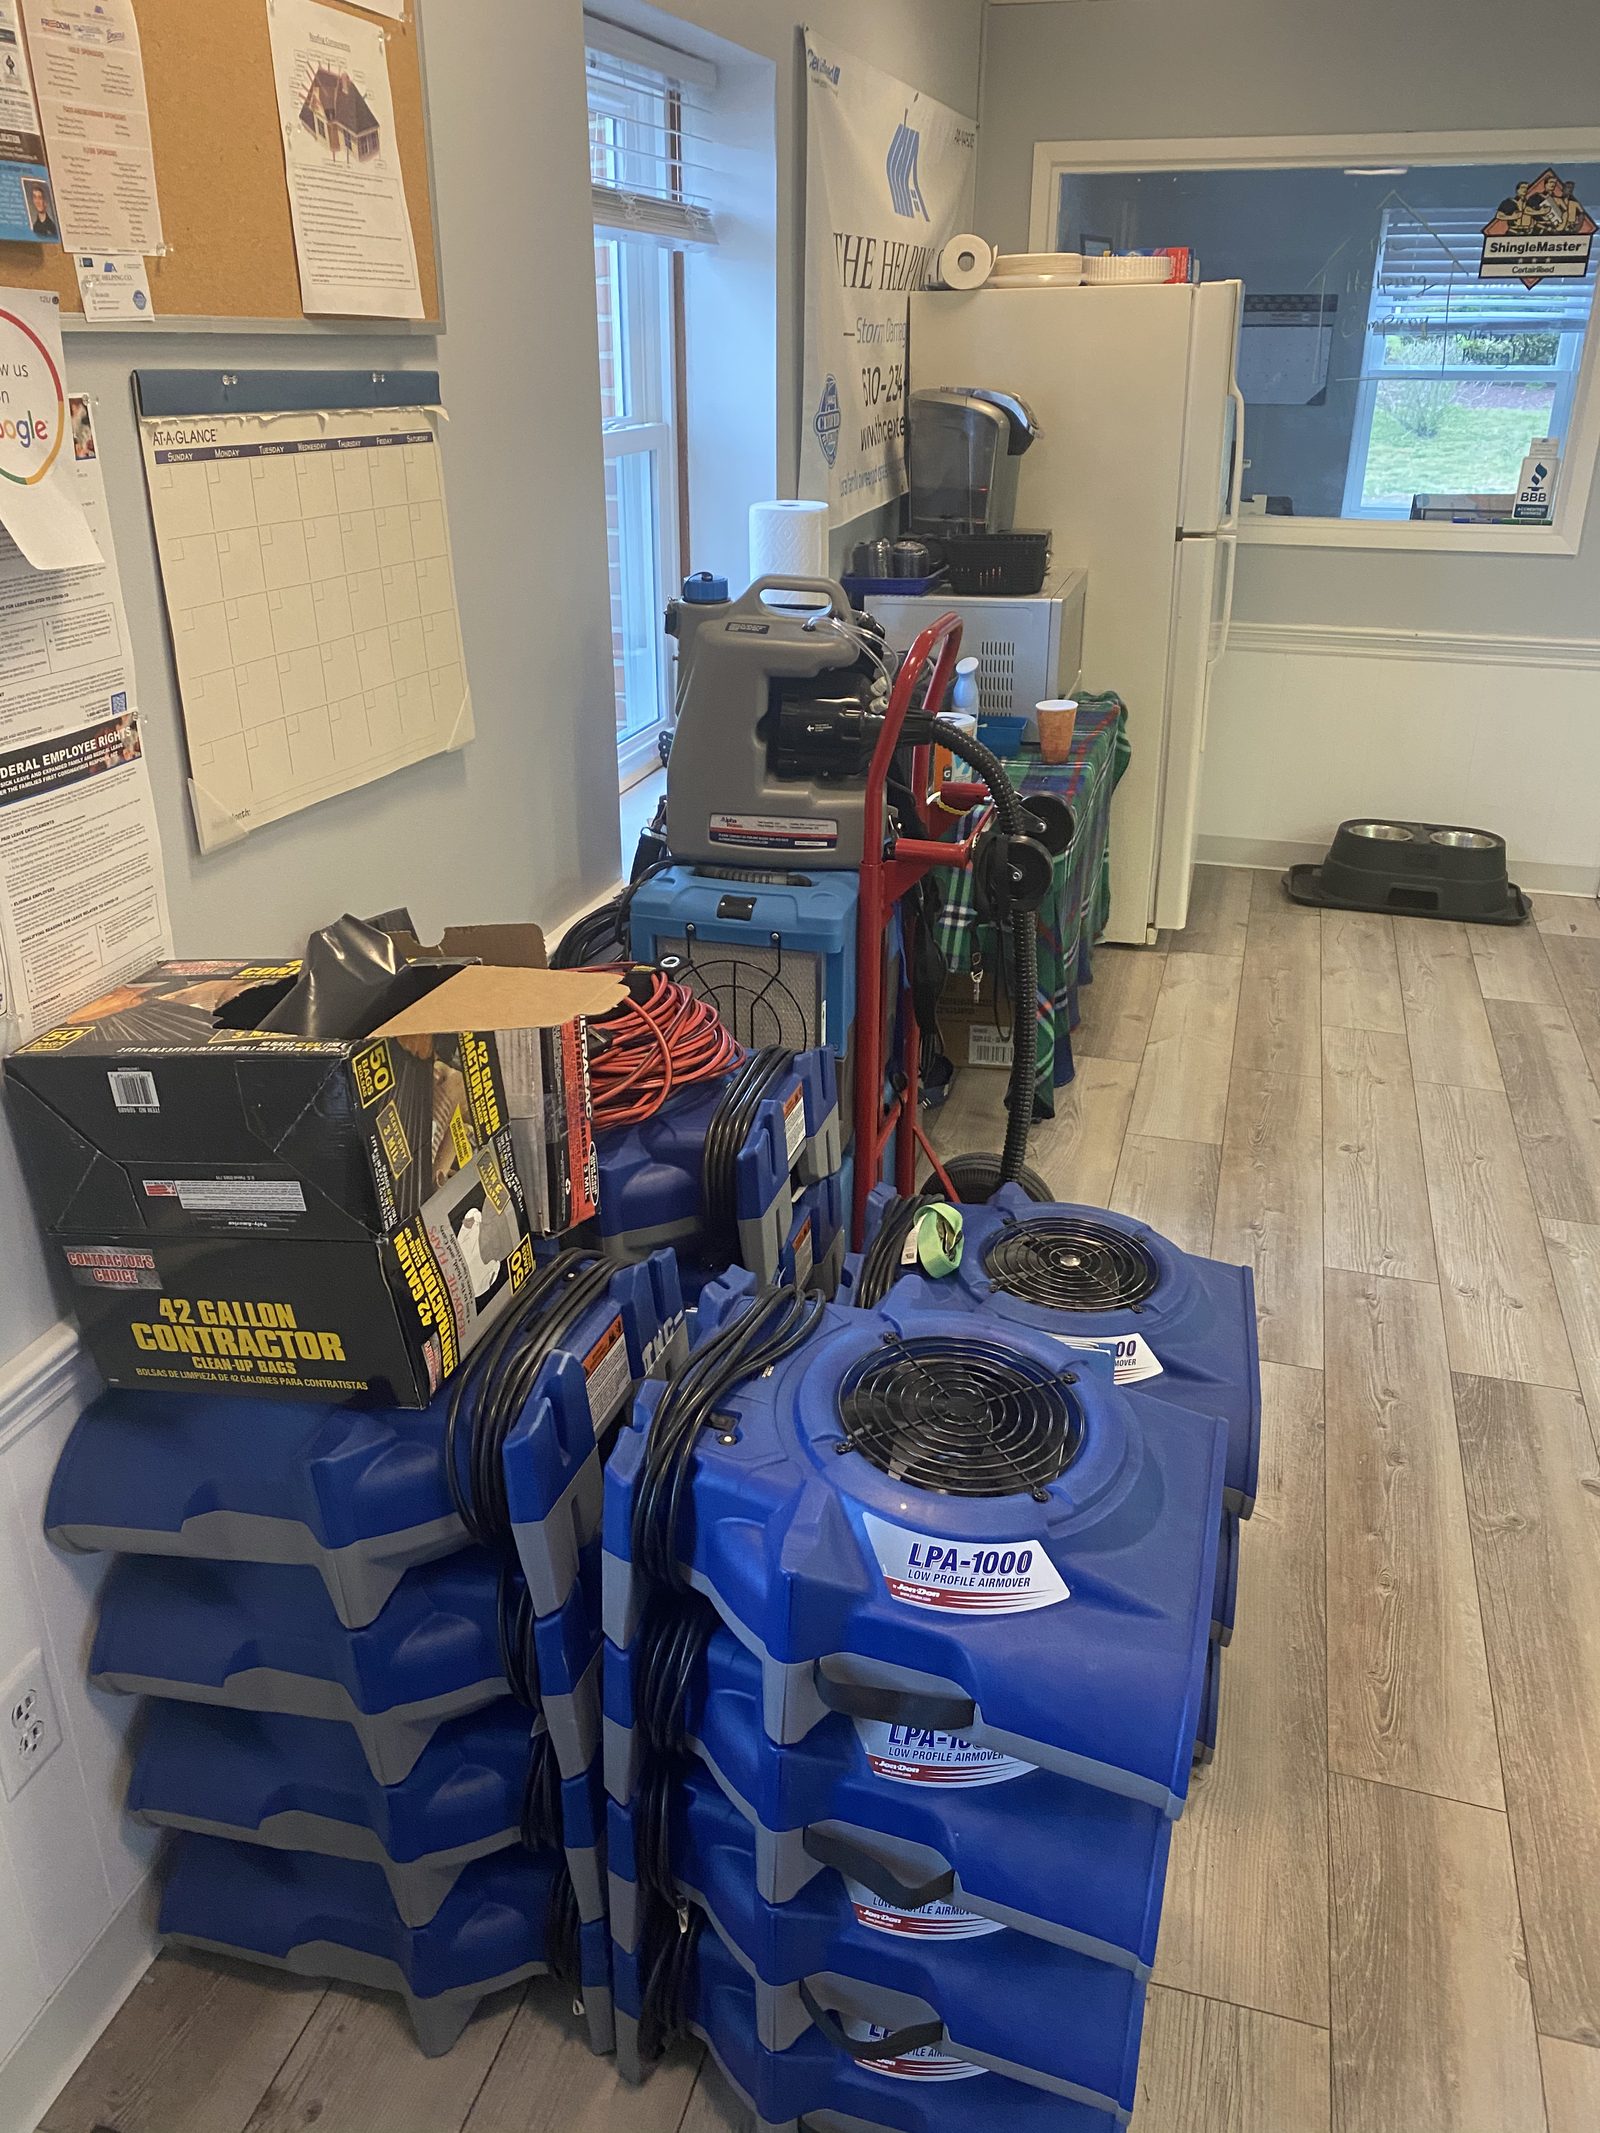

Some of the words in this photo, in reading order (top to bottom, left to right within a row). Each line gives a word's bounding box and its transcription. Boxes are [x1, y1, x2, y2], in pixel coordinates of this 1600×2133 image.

[1490, 241, 1581, 254] ShingleMaster
[833, 232, 876, 289] THE
[13, 364, 29, 377] us
[0, 390, 10, 404] n
[0, 410, 48, 448] ogle
[1521, 492, 1546, 502] BBB
[0, 758, 40, 779] DERAL
[42, 738, 97, 766] EMPLOYEE
[98, 726, 132, 747] RIGHTS
[13, 774, 30, 784] LEAVE
[30, 771, 42, 779] AND
[42, 762, 68, 775] EXPANDED
[19, 778, 42, 790] FAMILIES
[42, 774, 57, 783] FIRST
[943, 770, 951, 778] G
[720, 817, 737, 827] Alpha
[42, 1029, 84, 1042] 50
[461, 1029, 482, 1099] RACTOR
[475, 1040, 488, 1067] 42
[360, 1059, 374, 1095] BAGS
[369, 1045, 391, 1091] 50
[578, 1015, 591, 1119] LTRASAC
[479, 1066, 500, 1131] GALLON
[382, 1125, 391, 1134] 3
[386, 1136, 399, 1160] MIL
[485, 1162, 498, 1183] MIL
[403, 1227, 422, 1266] CLEAN-UP
[426, 1224, 449, 1264] FLAPS
[67, 1252, 156, 1269] CONTRACTOR'S
[392, 1230, 426, 1298] GALLON
[510, 1250, 523, 1285] 50
[93, 1269, 139, 1284] CHOICE
[159, 1298, 196, 1324] 42
[197, 1300, 297, 1329] GALLON
[415, 1298, 434, 1326] 42
[417, 1262, 454, 1378] CONTRACTOR
[130, 1322, 346, 1361] CONTRACTOR
[192, 1356, 254, 1373] CLEAN-UP
[259, 1361, 297, 1375] BAGS
[1115, 1358, 1137, 1368] MOVER
[135, 1367, 167, 1377] BOLSAS
[168, 1369, 179, 1378] DE
[180, 1370, 217, 1381] LIMPIEZA
[218, 1373, 229, 1382] DE
[230, 1374, 239, 1382] 42
[240, 1375, 279, 1385] GALONES
[279, 1377, 303, 1386] PARA
[304, 1378, 369, 1390] CONTRATISTAS
[907, 1542, 1033, 1575] LPA-1000
[908, 1569, 930, 1582] LOW
[933, 1574, 975, 1587] PROFILE
[978, 1577, 1031, 1588] AIRMOVER
[888, 1723, 986, 1750] LPA-10
[889, 1746, 911, 1758] LOW
[913, 1750, 952, 1762] PROFILE
